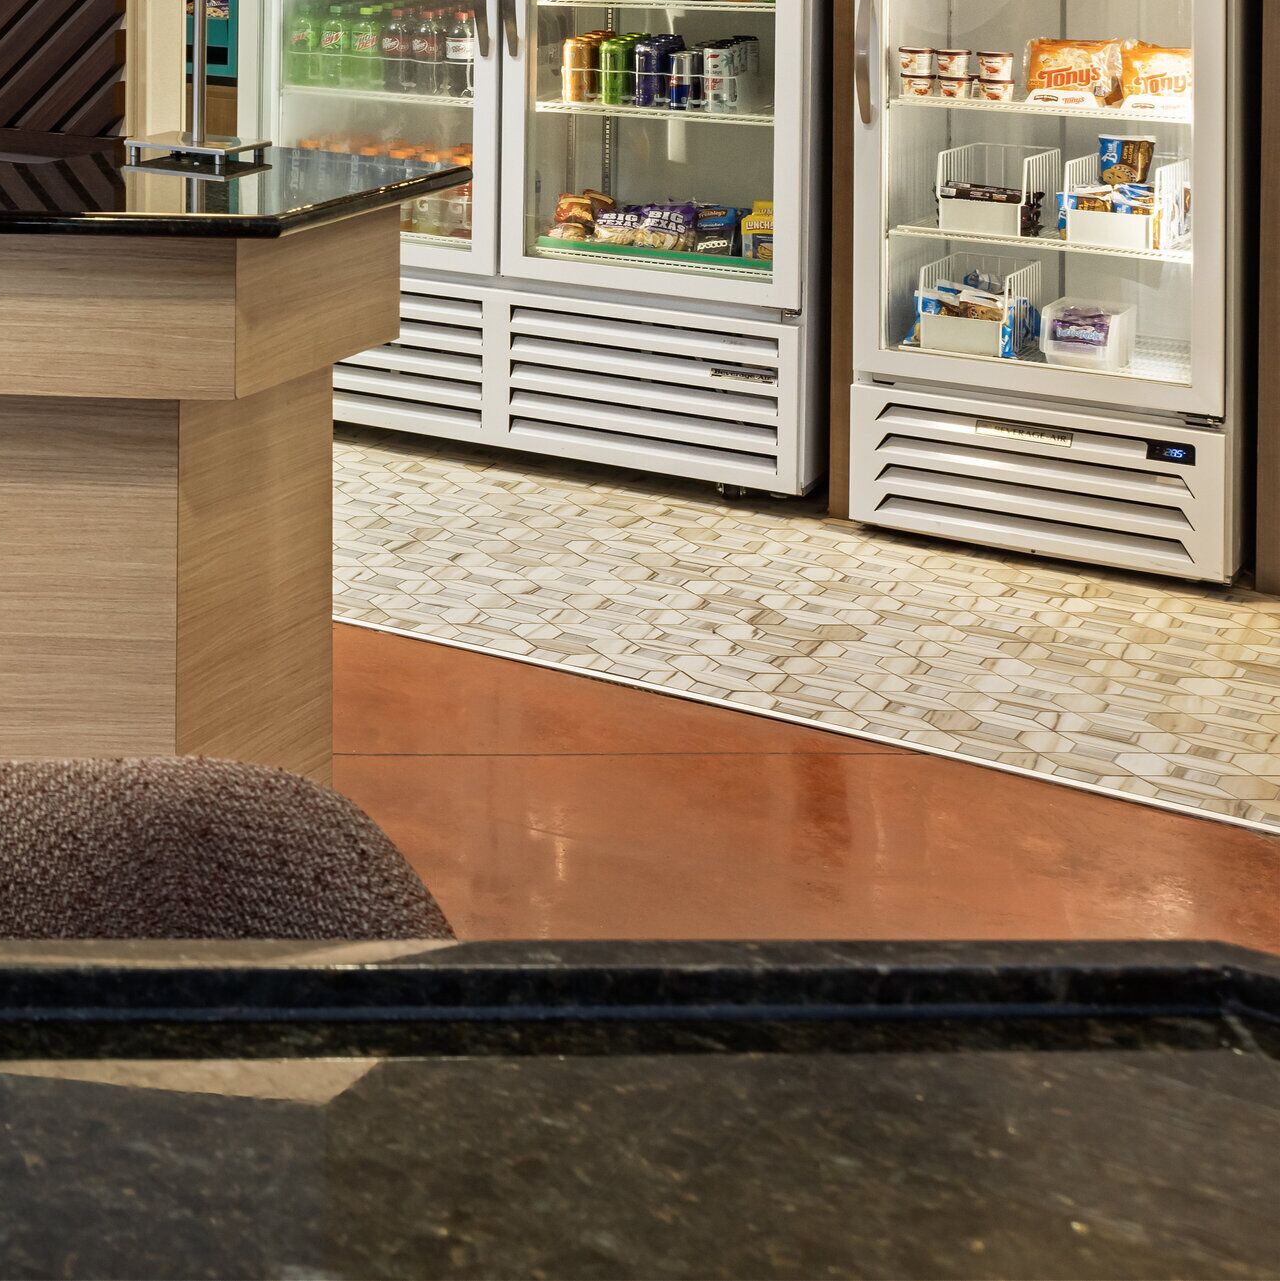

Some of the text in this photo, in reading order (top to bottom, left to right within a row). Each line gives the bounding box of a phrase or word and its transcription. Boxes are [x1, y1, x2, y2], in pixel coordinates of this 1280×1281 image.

[1037, 64, 1101, 88] Tony's
[602, 212, 638, 222] BIG
[648, 210, 684, 224] BIG
[597, 219, 640, 229] TEXAS
